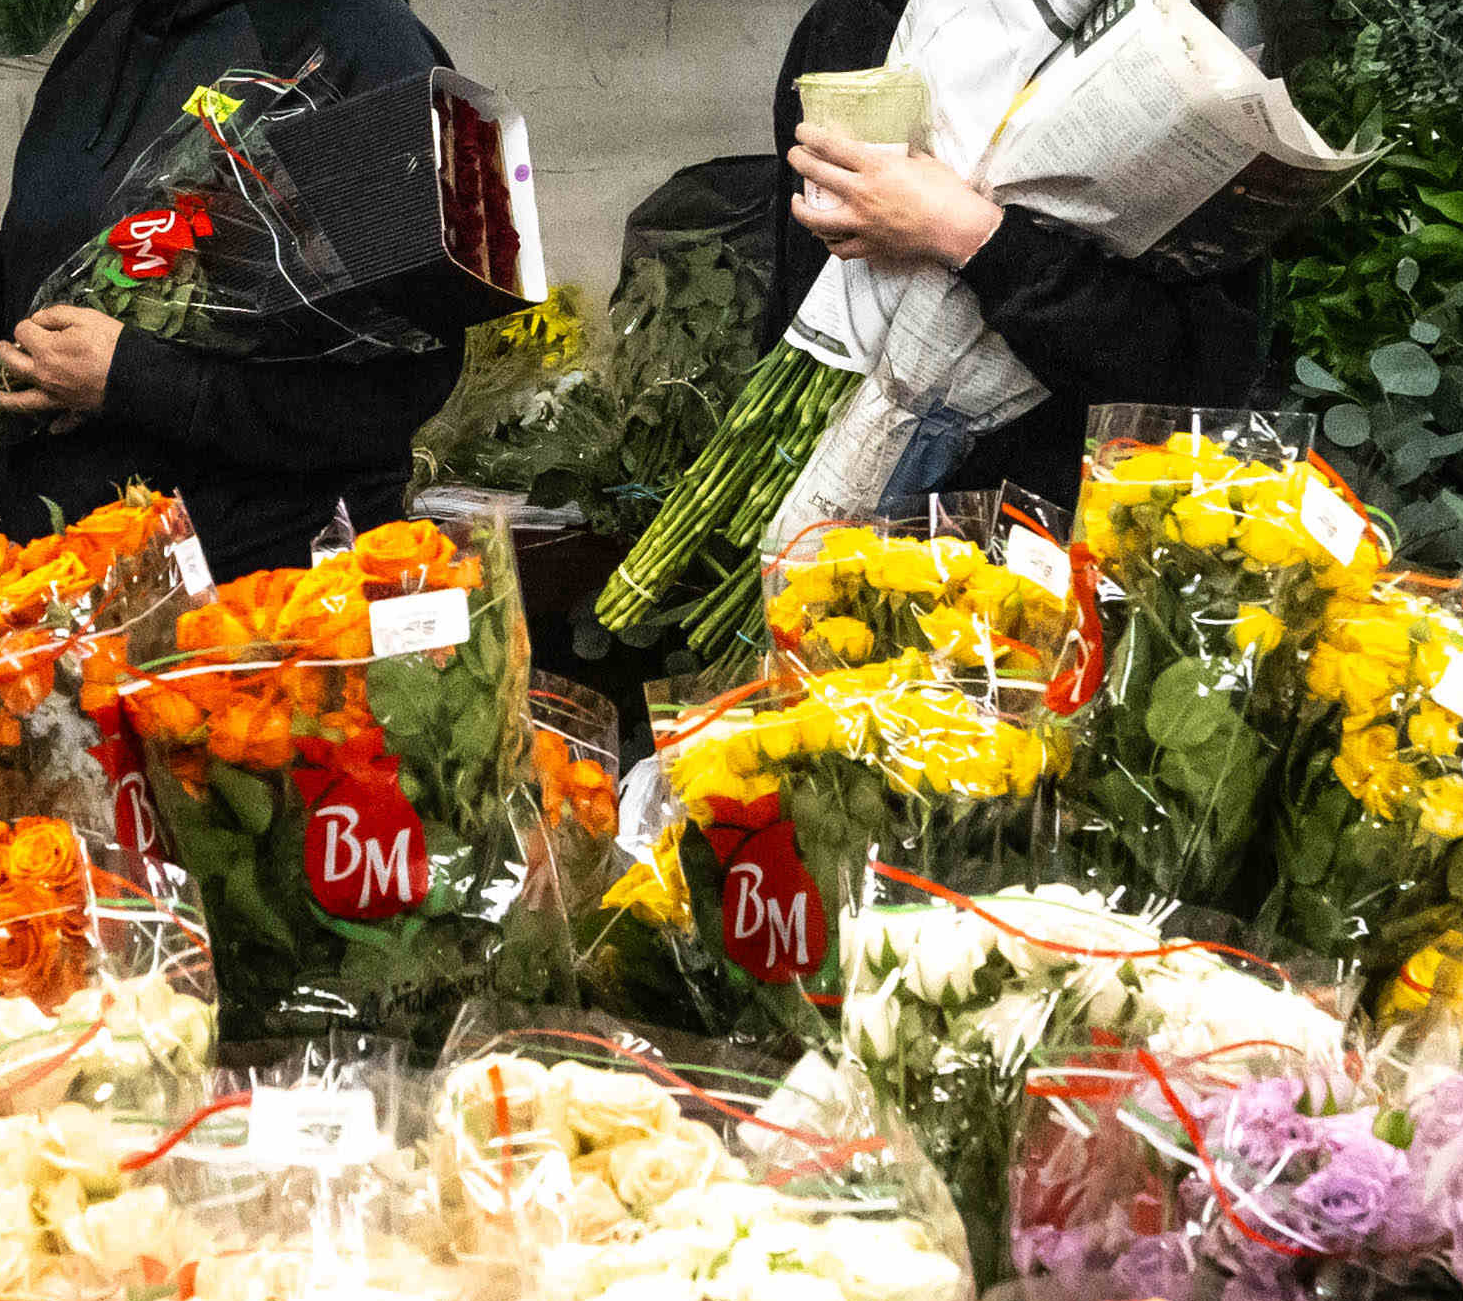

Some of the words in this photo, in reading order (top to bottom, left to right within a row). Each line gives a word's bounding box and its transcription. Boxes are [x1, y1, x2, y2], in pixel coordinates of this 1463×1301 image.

[117, 210, 176, 272] BM
[315, 804, 413, 909] BM
[729, 863, 808, 968] BM
